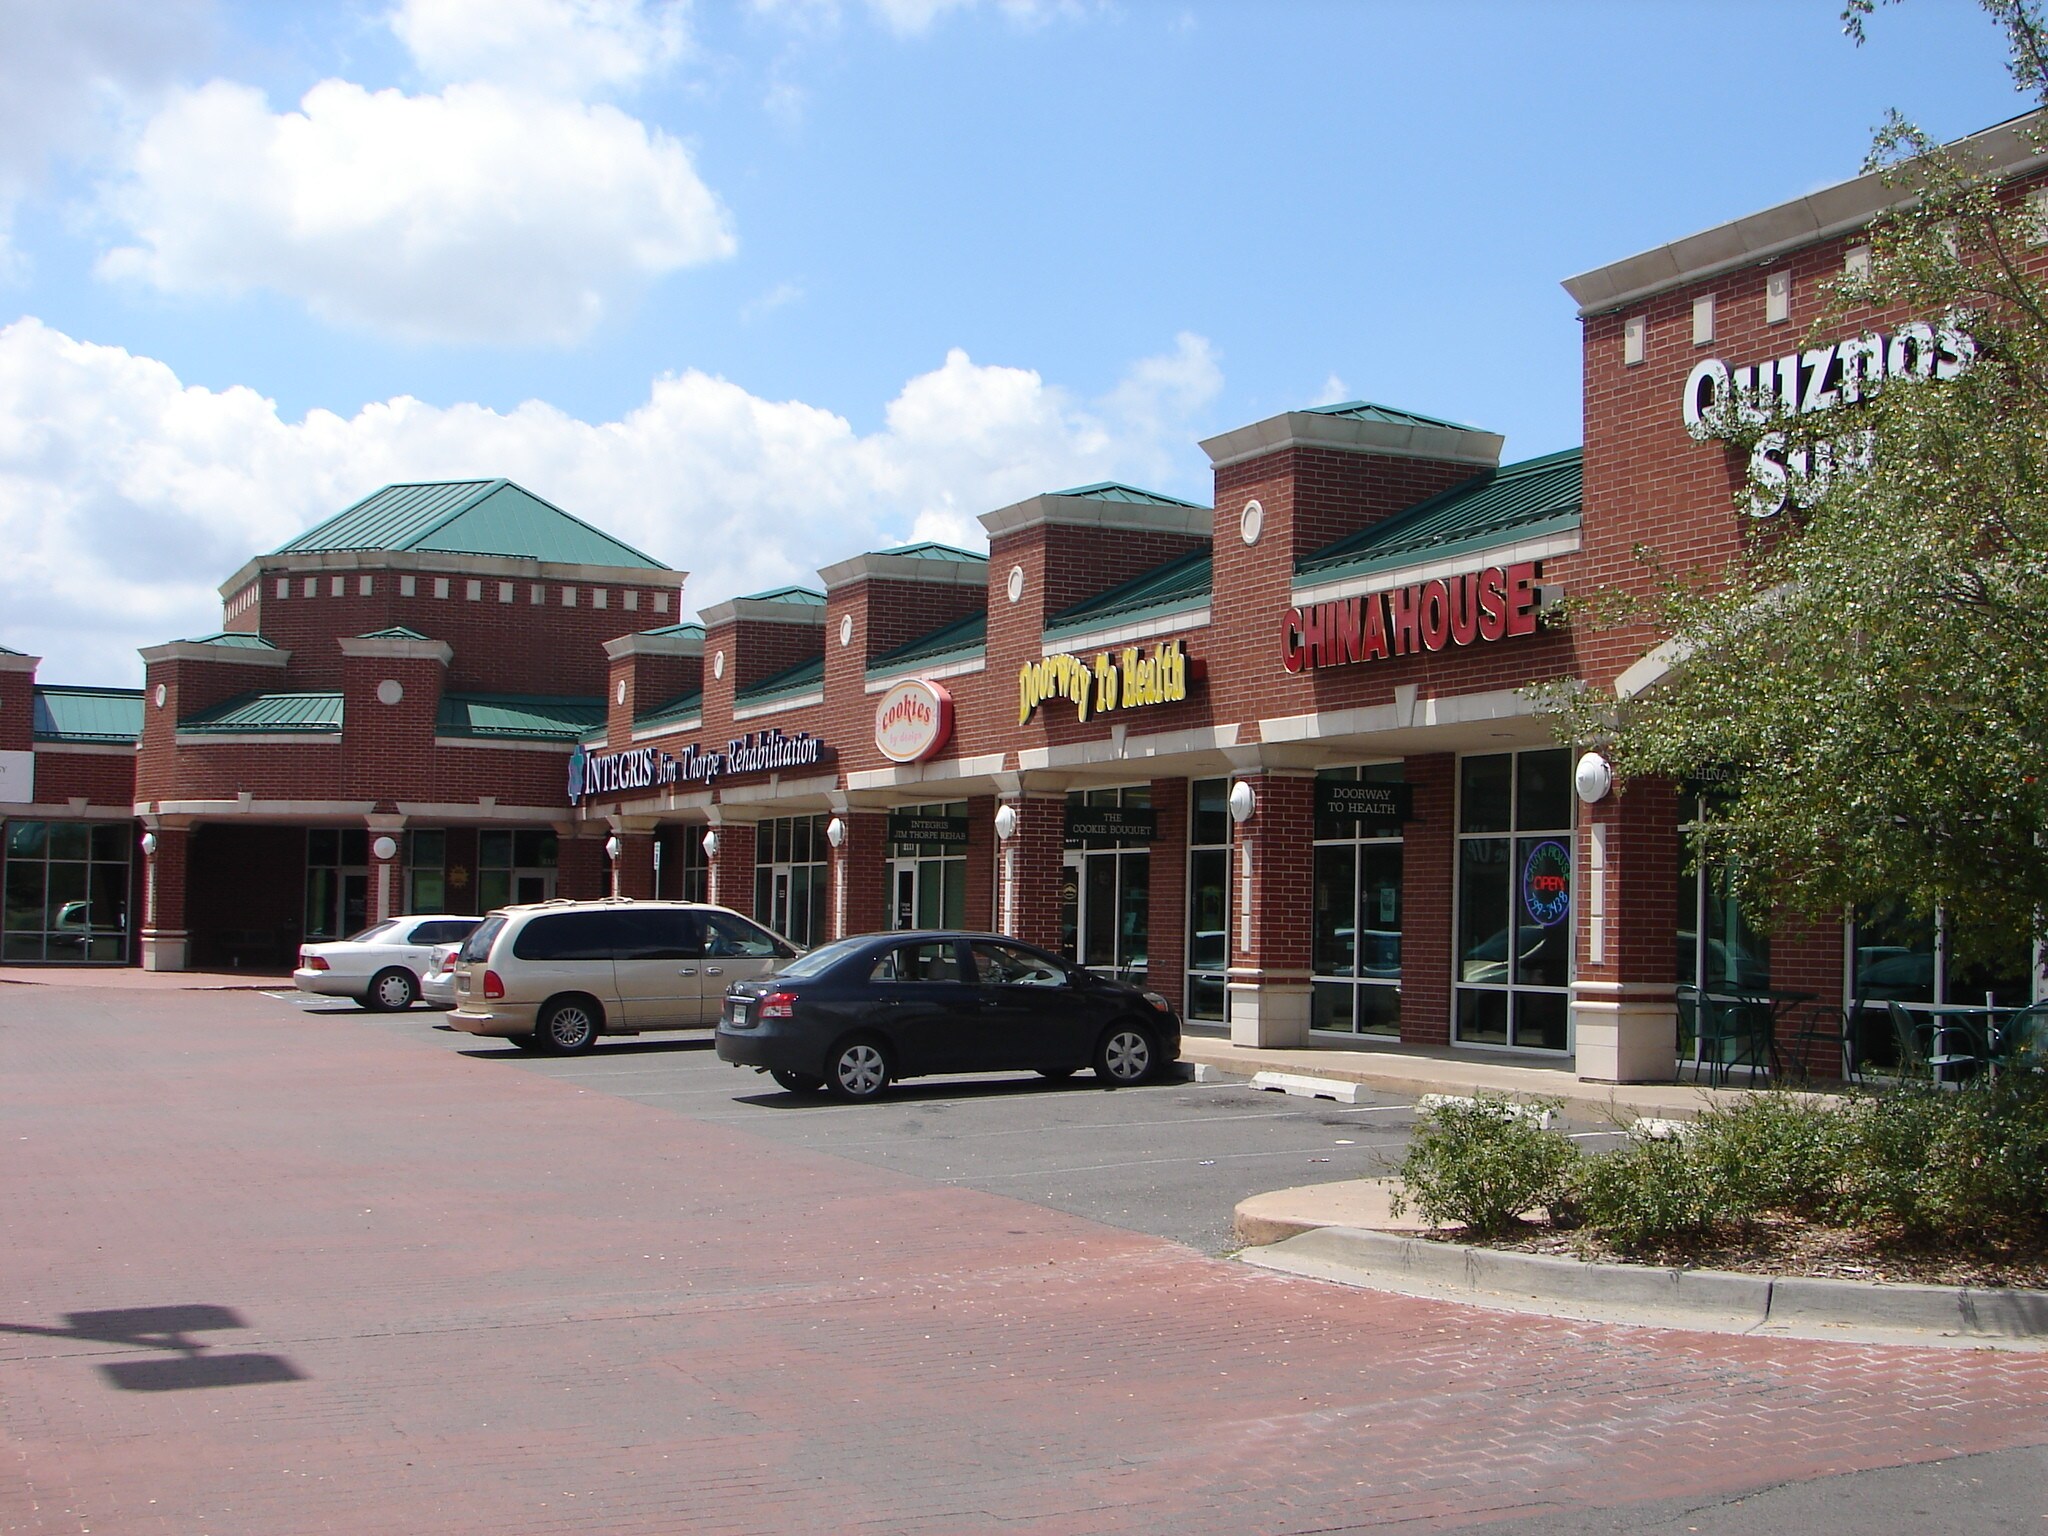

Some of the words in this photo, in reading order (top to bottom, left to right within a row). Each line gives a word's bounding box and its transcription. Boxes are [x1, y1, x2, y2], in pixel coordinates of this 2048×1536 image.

[1281, 592, 1389, 674] CHINA
[1394, 560, 1537, 656] HOUSE
[1019, 653, 1092, 726] Doorway
[1122, 639, 1187, 709] Health
[882, 693, 931, 731] cookies
[584, 747, 656, 794] INTEGRIS
[657, 752, 677, 784] Jim
[682, 743, 720, 785] Thorpe
[727, 731, 819, 774] Rehabilitation
[1333, 788, 1391, 800] DOORWAY
[1328, 802, 1344, 812] TO
[1348, 802, 1396, 814] HEALTH
[1104, 813, 1122, 822] THE
[911, 820, 949, 830] INTEGRIS
[1073, 824, 1107, 834] COOKIE
[1110, 825, 1152, 835] BOUQUET
[895, 830, 908, 839] JIM
[909, 830, 939, 840] THORPE
[940, 831, 966, 840] REHAB
[1533, 875, 1566, 892] OPEN
